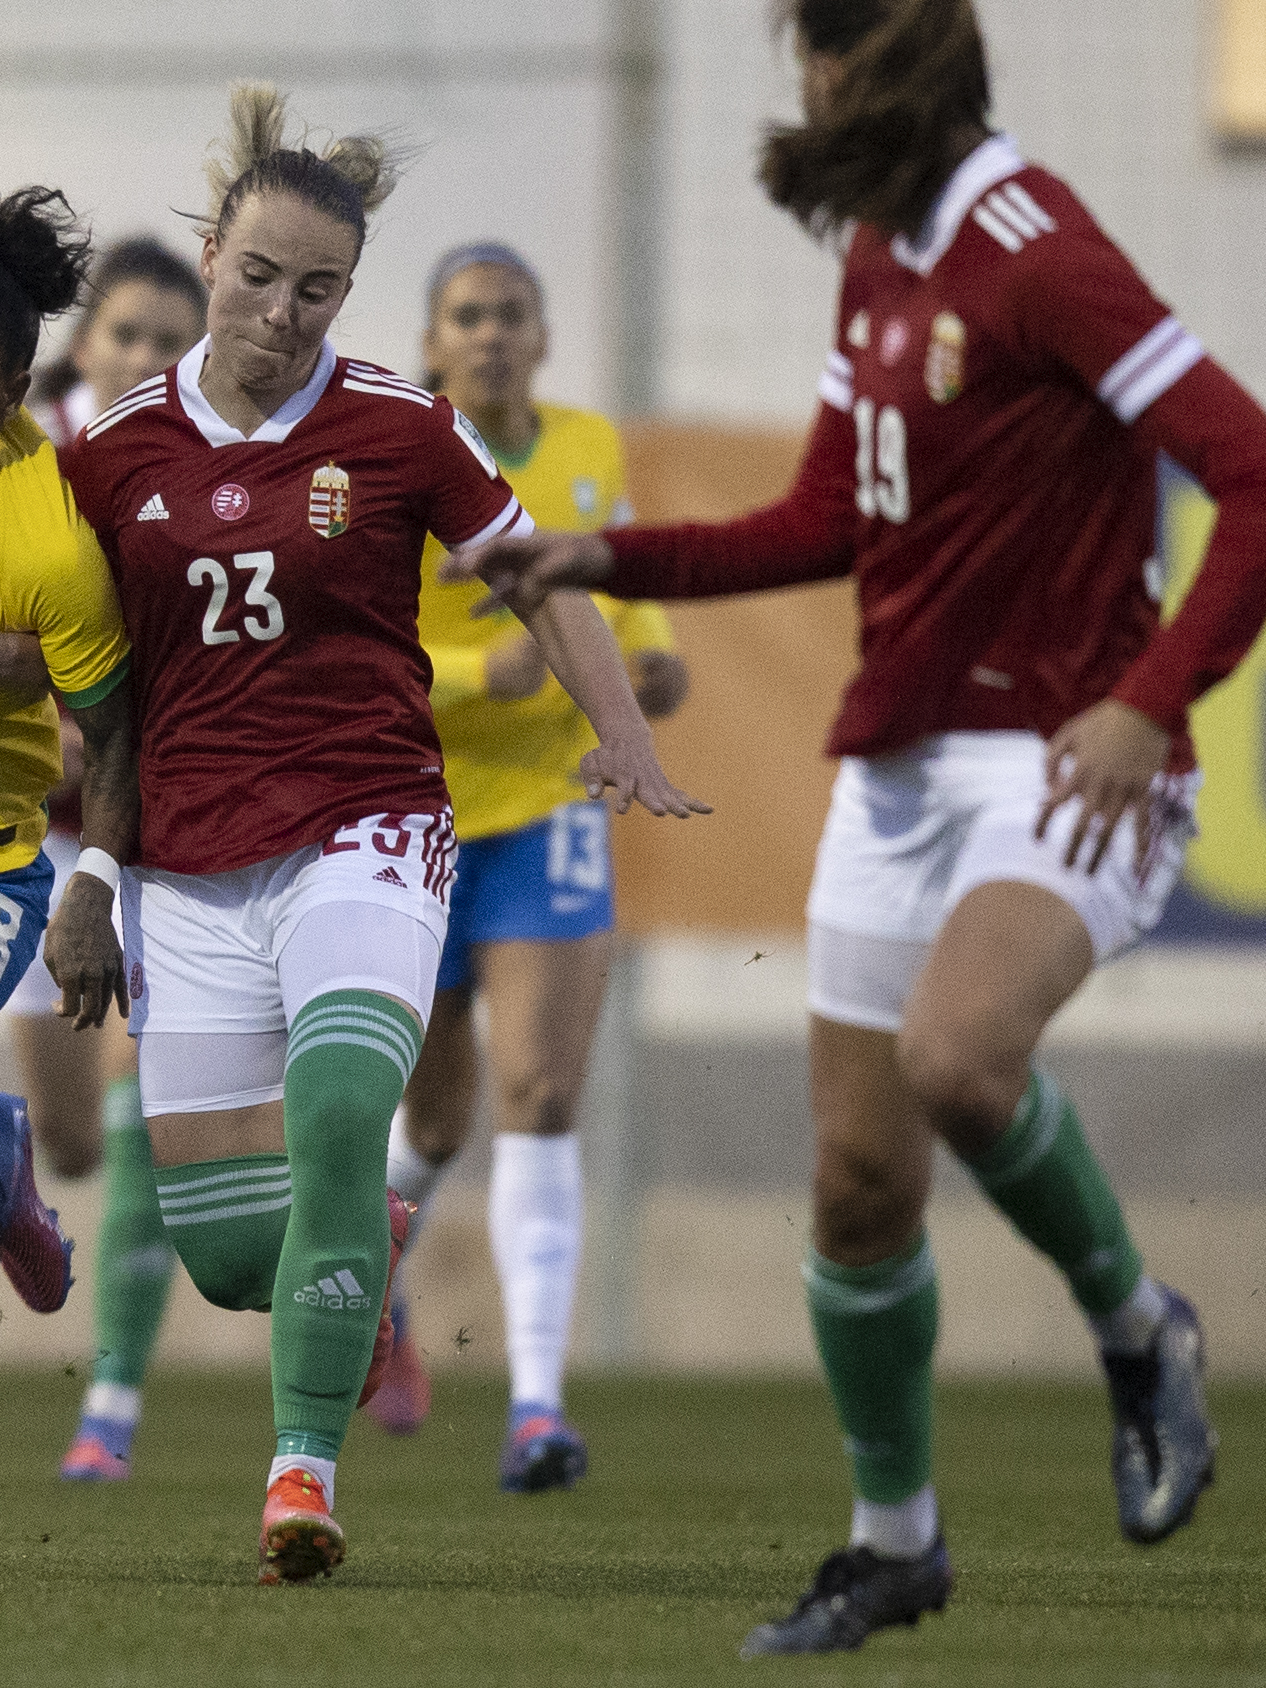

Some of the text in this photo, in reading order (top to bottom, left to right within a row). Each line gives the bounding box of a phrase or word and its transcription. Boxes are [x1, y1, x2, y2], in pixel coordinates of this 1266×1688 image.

[853, 398, 911, 524] 19
[187, 551, 284, 645] 23
[548, 804, 608, 889] 13
[294, 1286, 370, 1310] adidas
